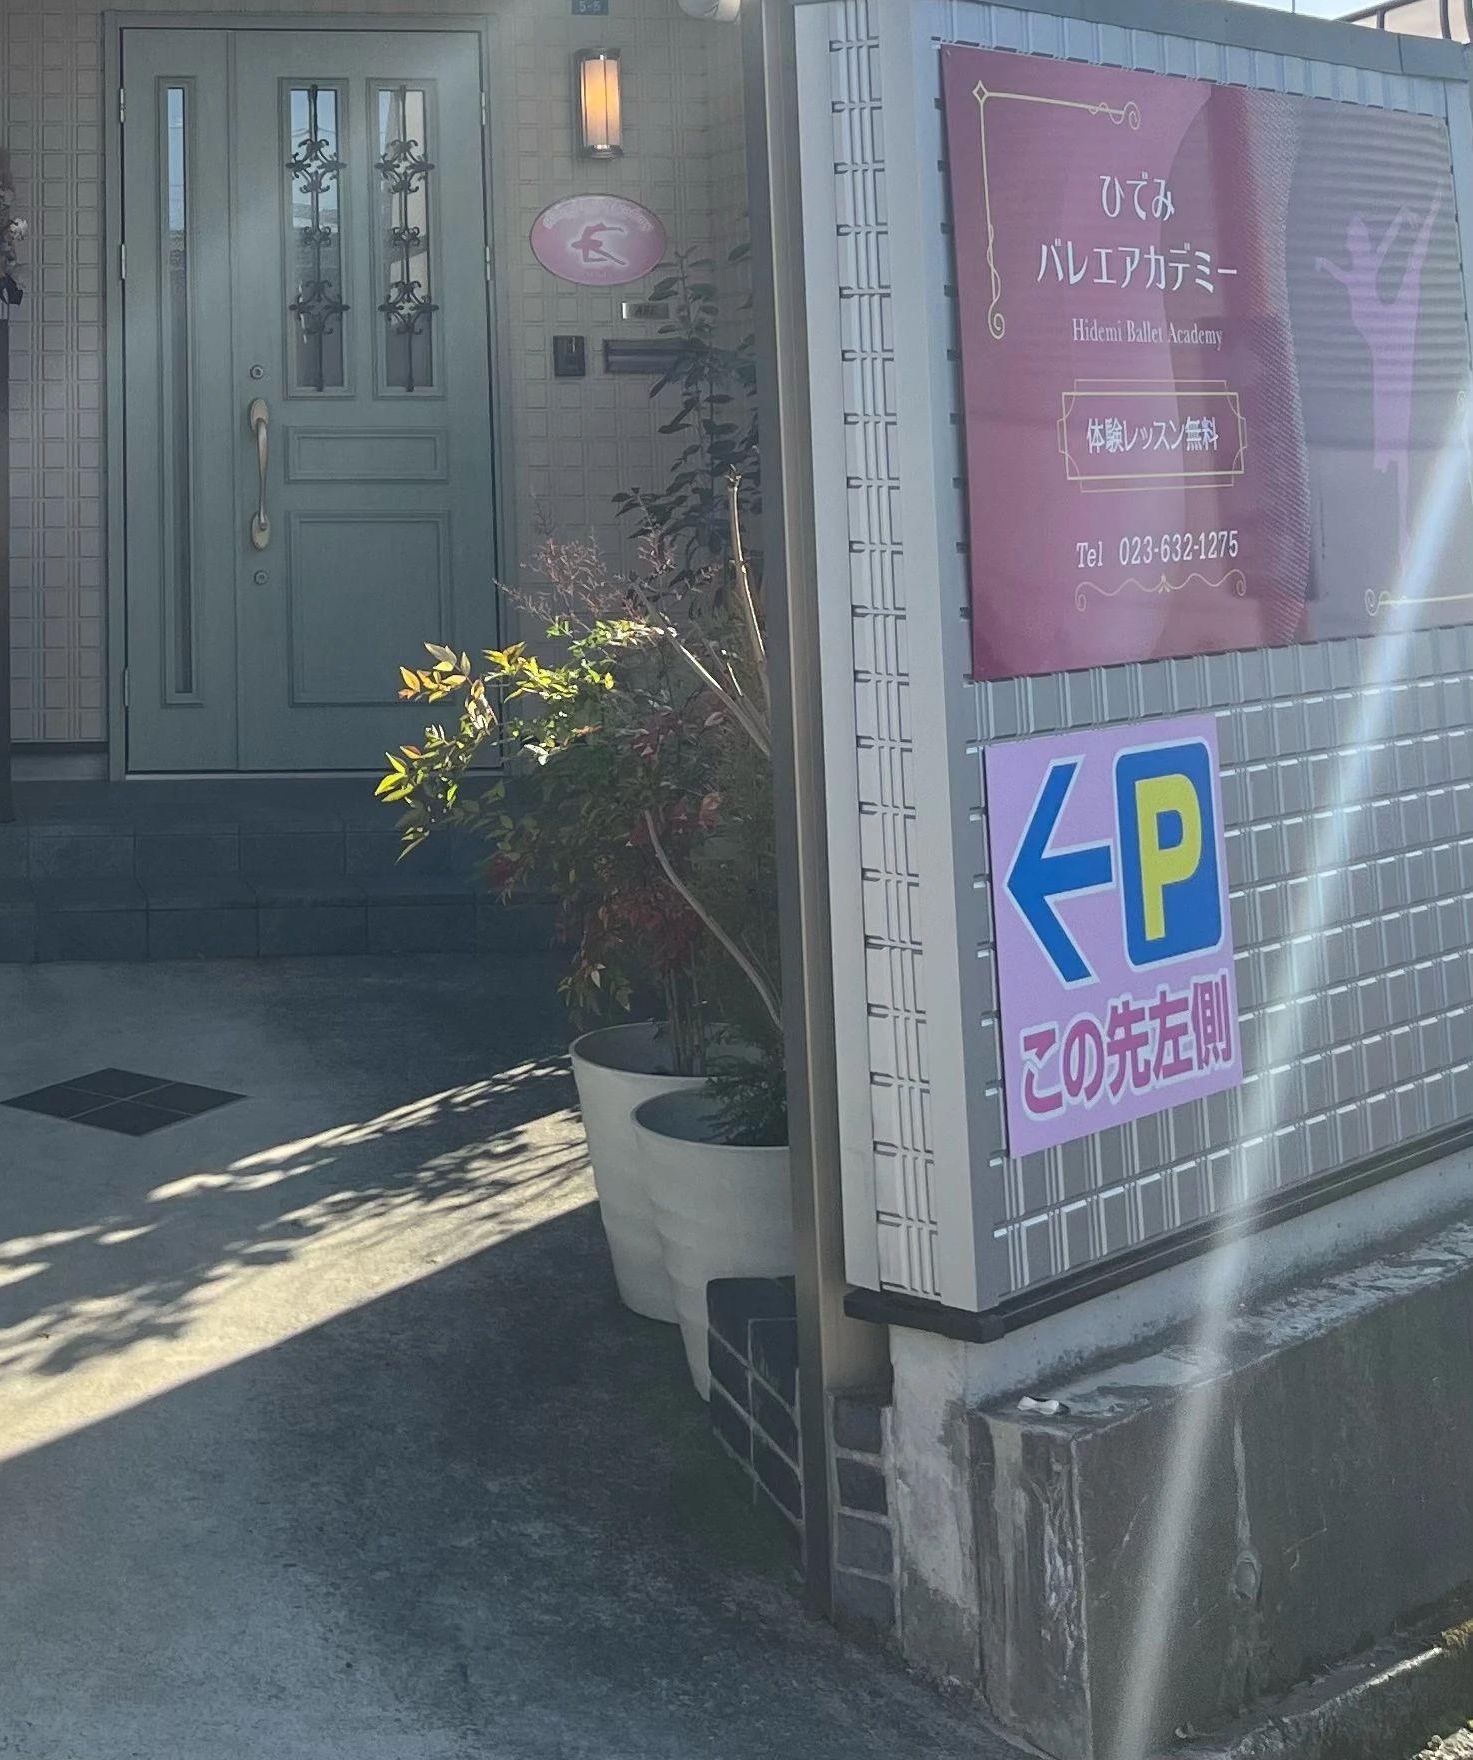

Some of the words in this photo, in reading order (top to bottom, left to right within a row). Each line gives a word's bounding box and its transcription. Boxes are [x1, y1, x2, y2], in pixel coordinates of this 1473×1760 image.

[1099, 171, 1175, 221] ひでみ
[1037, 238, 1237, 293] バレエアカデミー
[1072, 318, 1122, 342] Hidemi
[1126, 319, 1164, 344] Ballet
[1167, 321, 1223, 351] Academy
[1086, 416, 1219, 454] 体験レッスン無料
[1076, 541, 1103, 568] Tel
[1119, 530, 1239, 566] 023-632-1275
[1134, 773, 1202, 941] P
[1021, 971, 1233, 1117] この先左側
